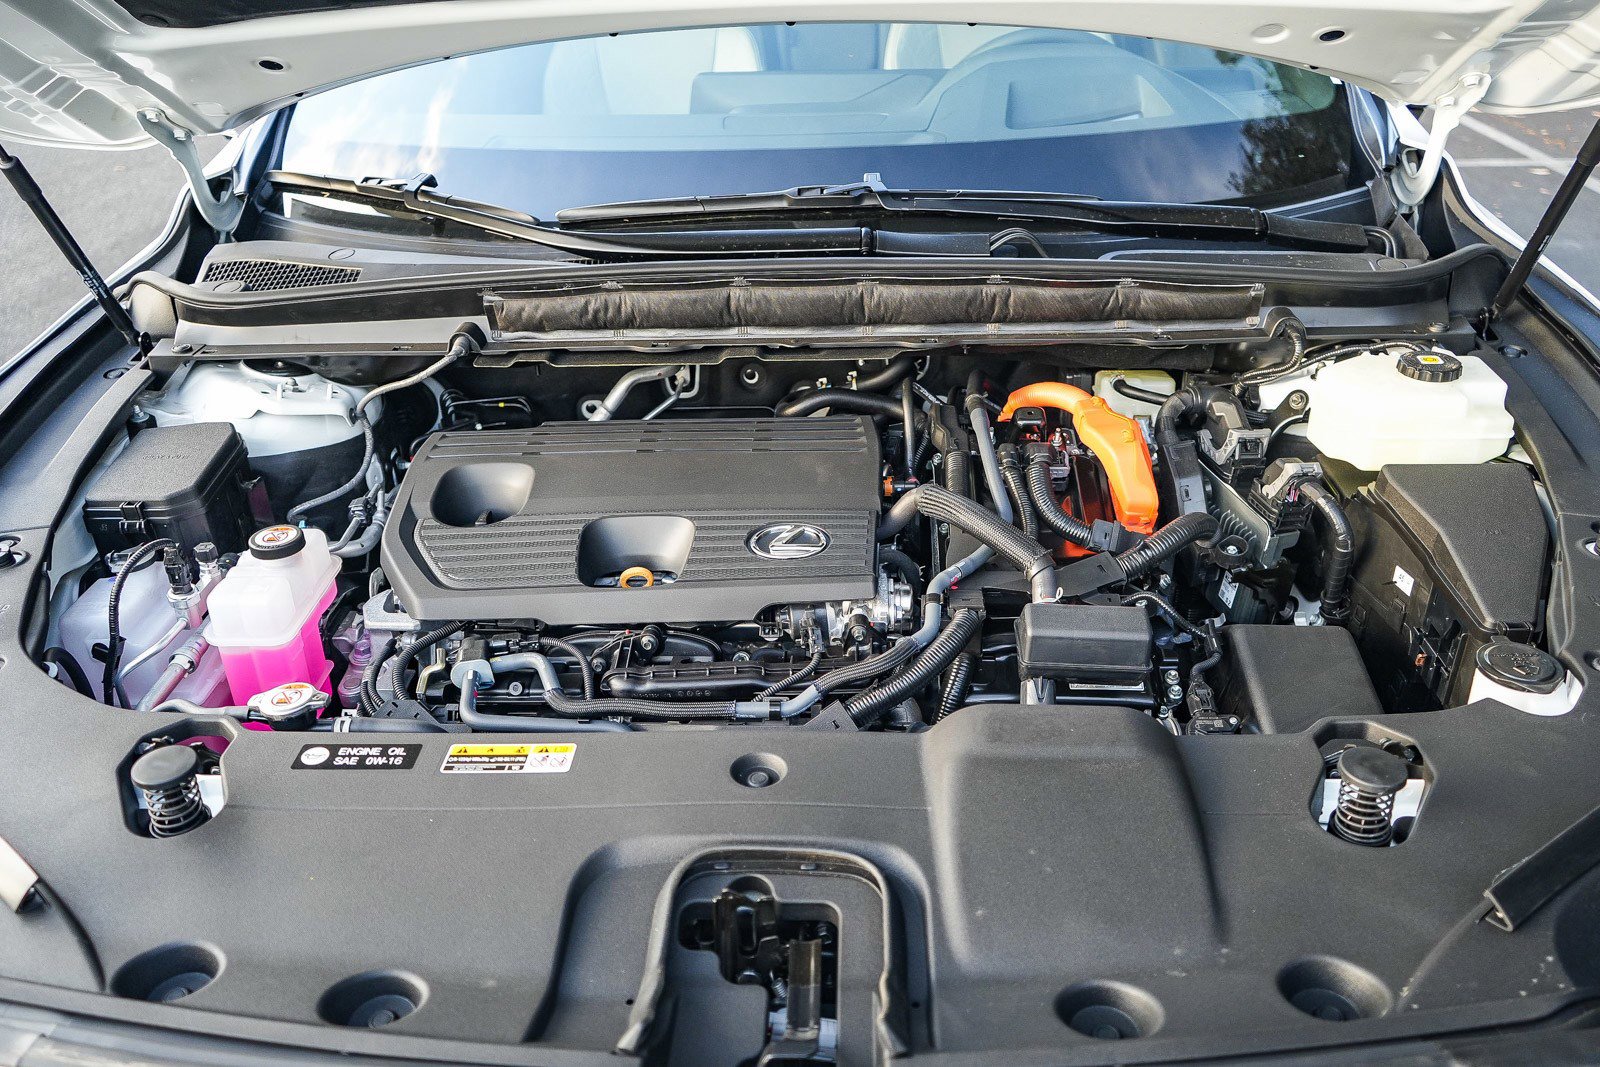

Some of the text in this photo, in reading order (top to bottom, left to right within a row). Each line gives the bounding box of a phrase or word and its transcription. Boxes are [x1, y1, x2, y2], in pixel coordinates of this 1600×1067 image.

[337, 746, 407, 756] ENGINE OIL
[333, 757, 403, 766] SAE 0W-16
